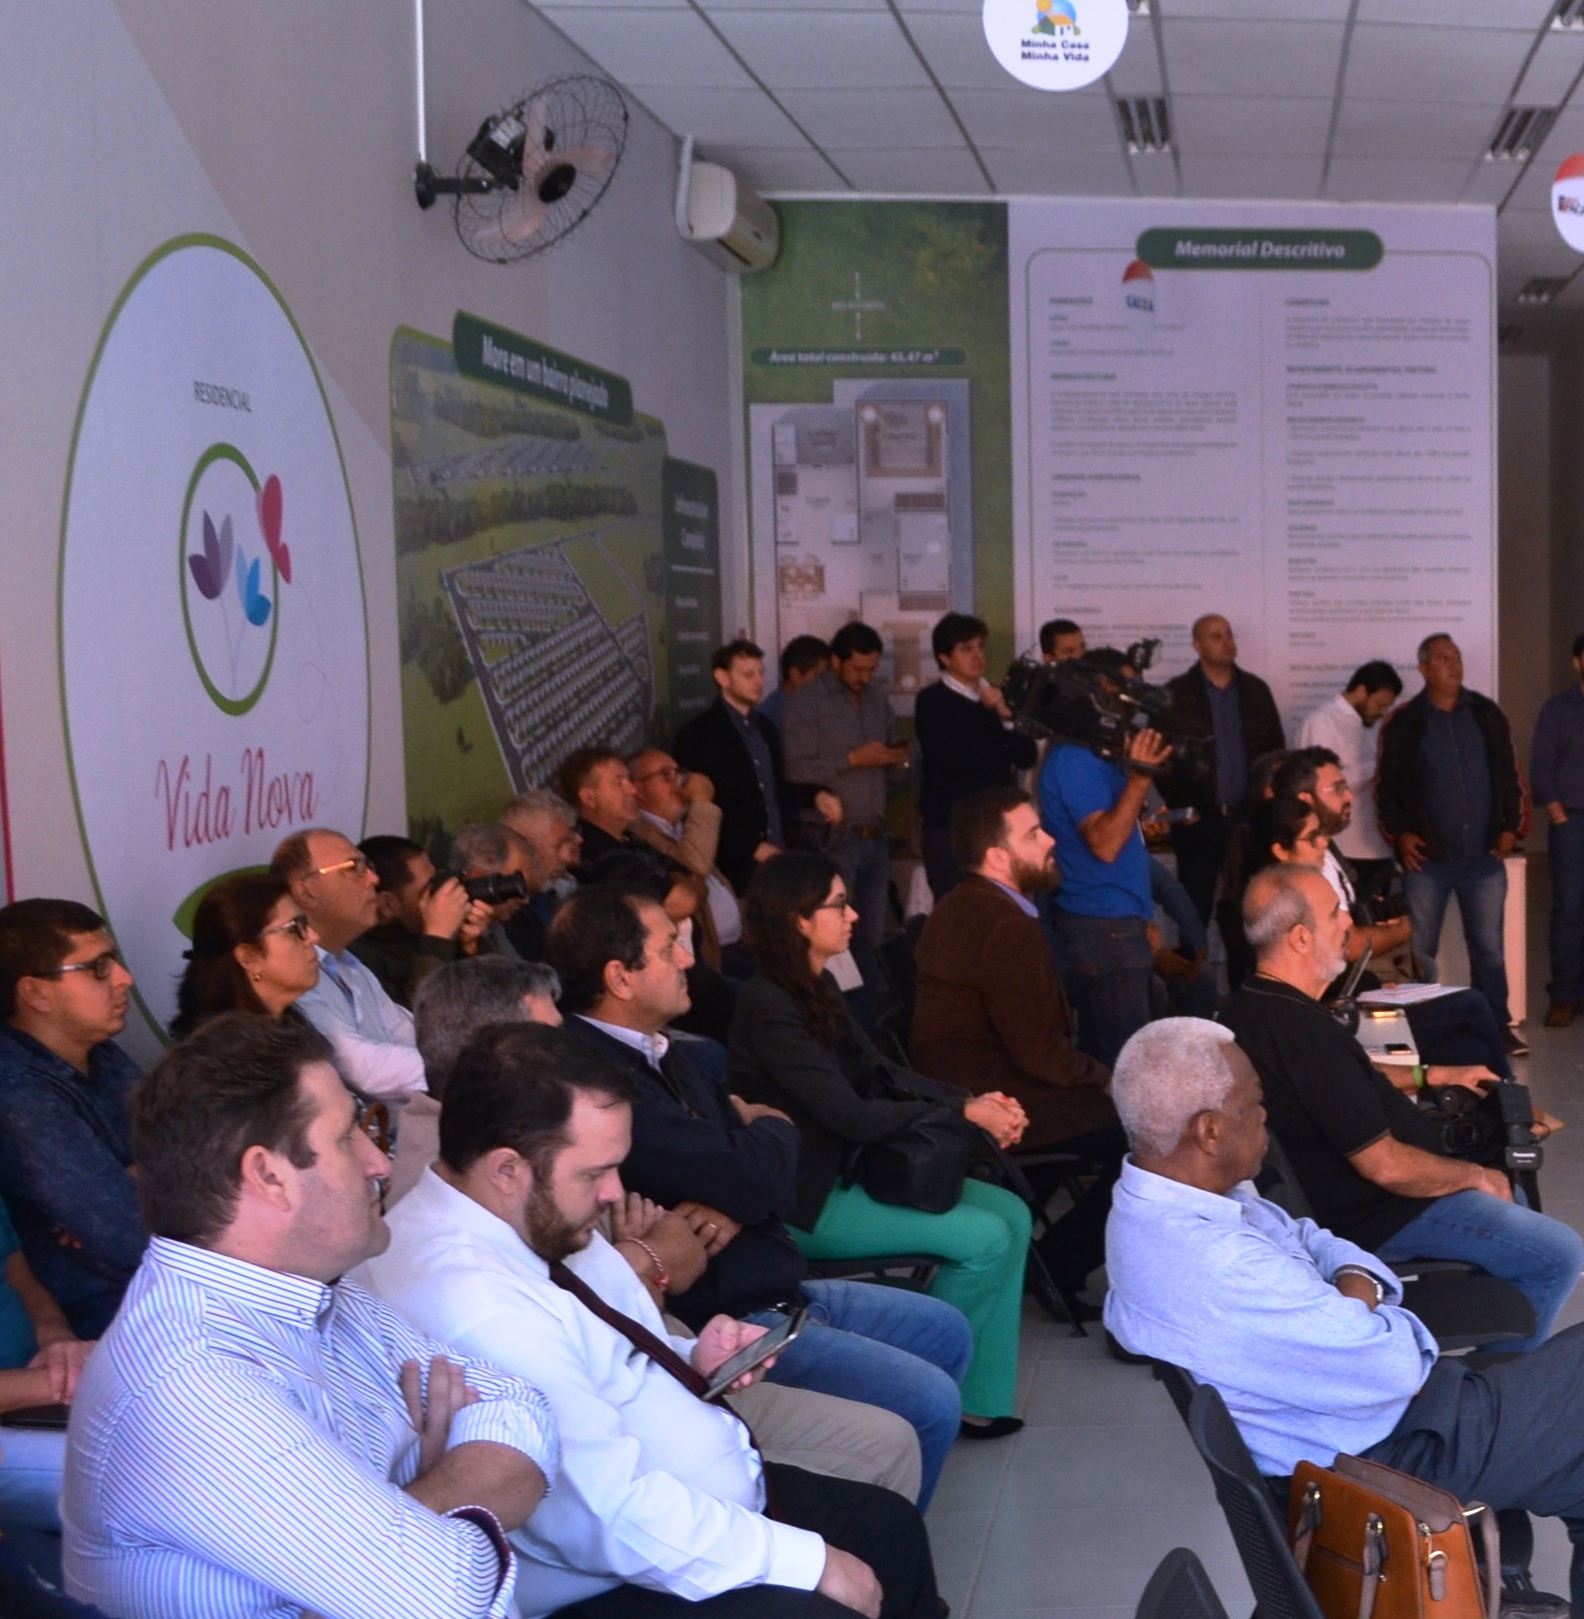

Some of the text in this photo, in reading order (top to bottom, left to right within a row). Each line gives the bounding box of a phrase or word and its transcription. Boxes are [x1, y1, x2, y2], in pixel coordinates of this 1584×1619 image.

[1021, 39, 1089, 49] Minha Casa
[1021, 52, 1089, 61] Minha Vida
[1175, 239, 1346, 258] Memorial Descritivo
[193, 381, 253, 413] RESIDENCIAL
[155, 747, 317, 851] Vida Nova
